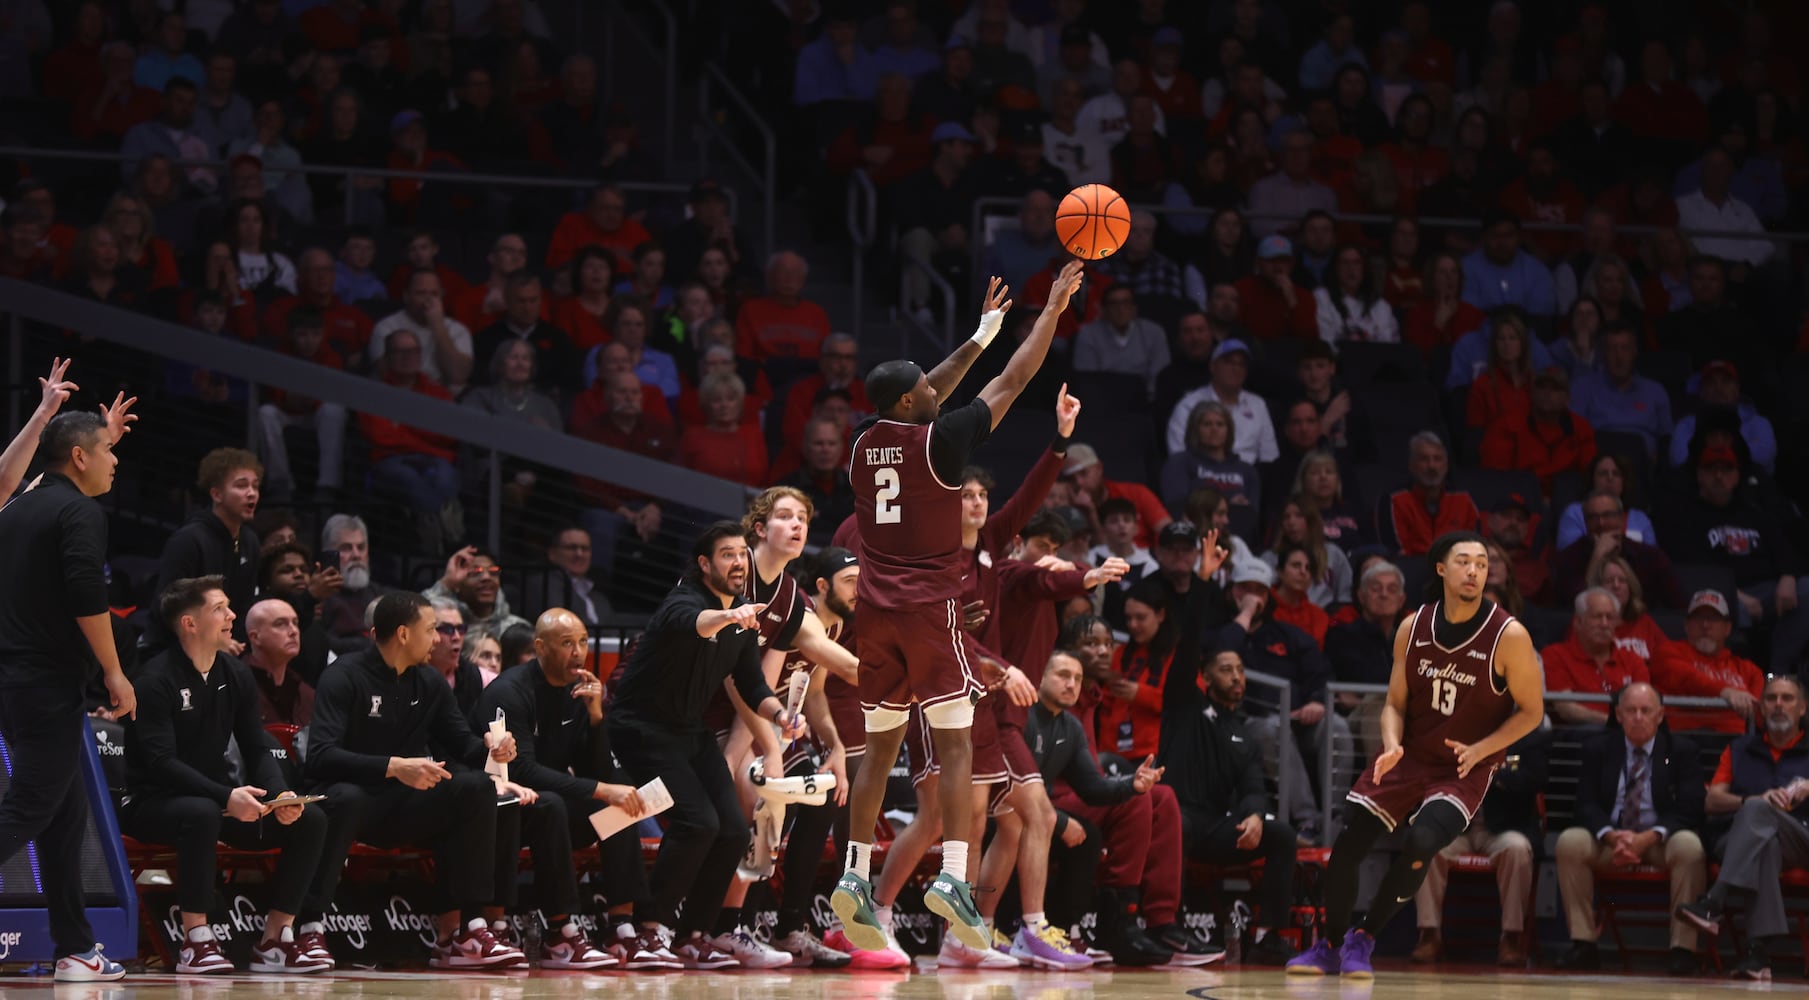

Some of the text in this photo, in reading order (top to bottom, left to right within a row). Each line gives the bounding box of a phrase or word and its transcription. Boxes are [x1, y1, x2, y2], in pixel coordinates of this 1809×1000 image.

[865, 446, 904, 466] REAVES
[874, 467, 902, 525] 2
[1417, 658, 1477, 686] Fordham
[1431, 679, 1457, 716] 13
